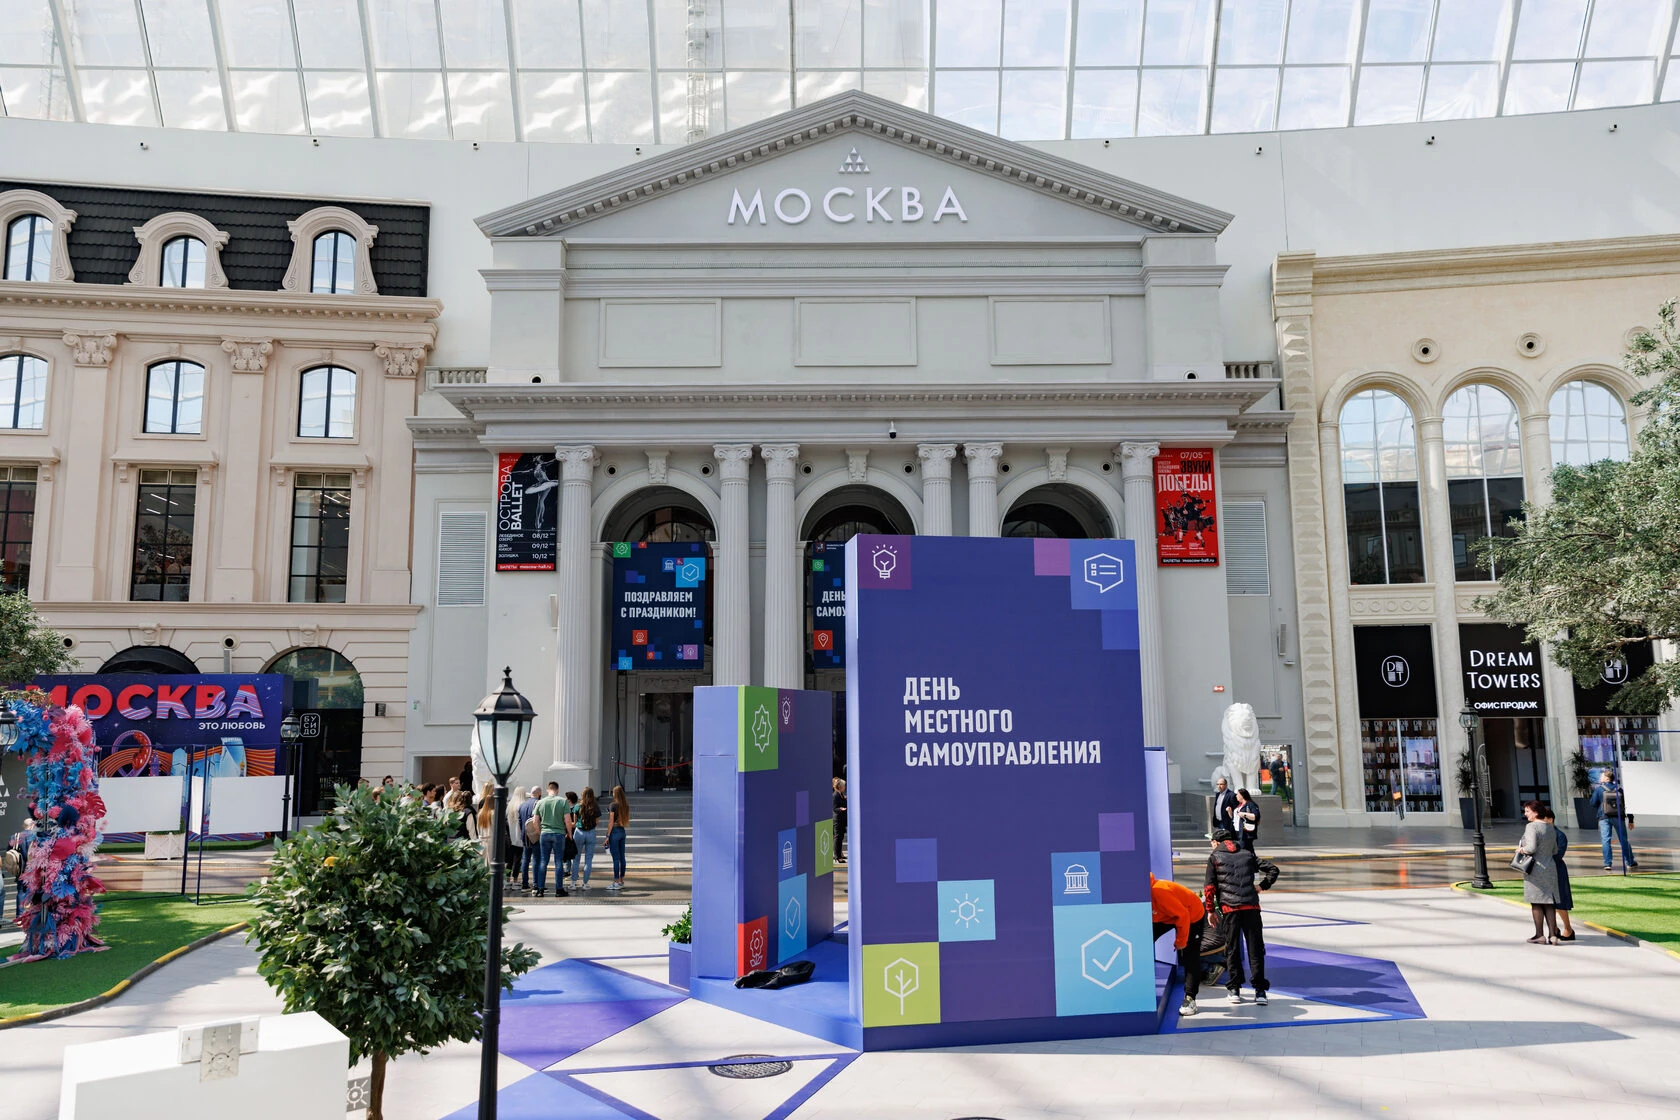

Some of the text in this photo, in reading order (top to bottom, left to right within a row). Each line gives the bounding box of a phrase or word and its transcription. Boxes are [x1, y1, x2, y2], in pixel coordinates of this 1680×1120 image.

[728, 185, 968, 225] МОСКВА
[1180, 452, 1203, 460] 07/05
[1180, 460, 1211, 474] ЗВУКИ
[1158, 474, 1212, 493] ПОБЕДЫ
[499, 465, 512, 531] ОСТРОВА
[511, 482, 523, 530] BALLET
[624, 591, 693, 604] ПОЗДРАВЛЯЕМ
[621, 607, 697, 619] С ПРАЗДНИКОМ!
[1470, 650, 1533, 667] DREAM
[1466, 672, 1541, 689] TOWERS
[903, 677, 961, 705] ДЕНЬ
[1474, 701, 1538, 710] ОФИС ПРОДАЖ
[198, 721, 266, 730] ЭТО ЛЮБОВЬ
[904, 709, 1013, 733] МЕСТНОГО
[904, 740, 1101, 767] САМОУПРАВЛЕНИЯ
